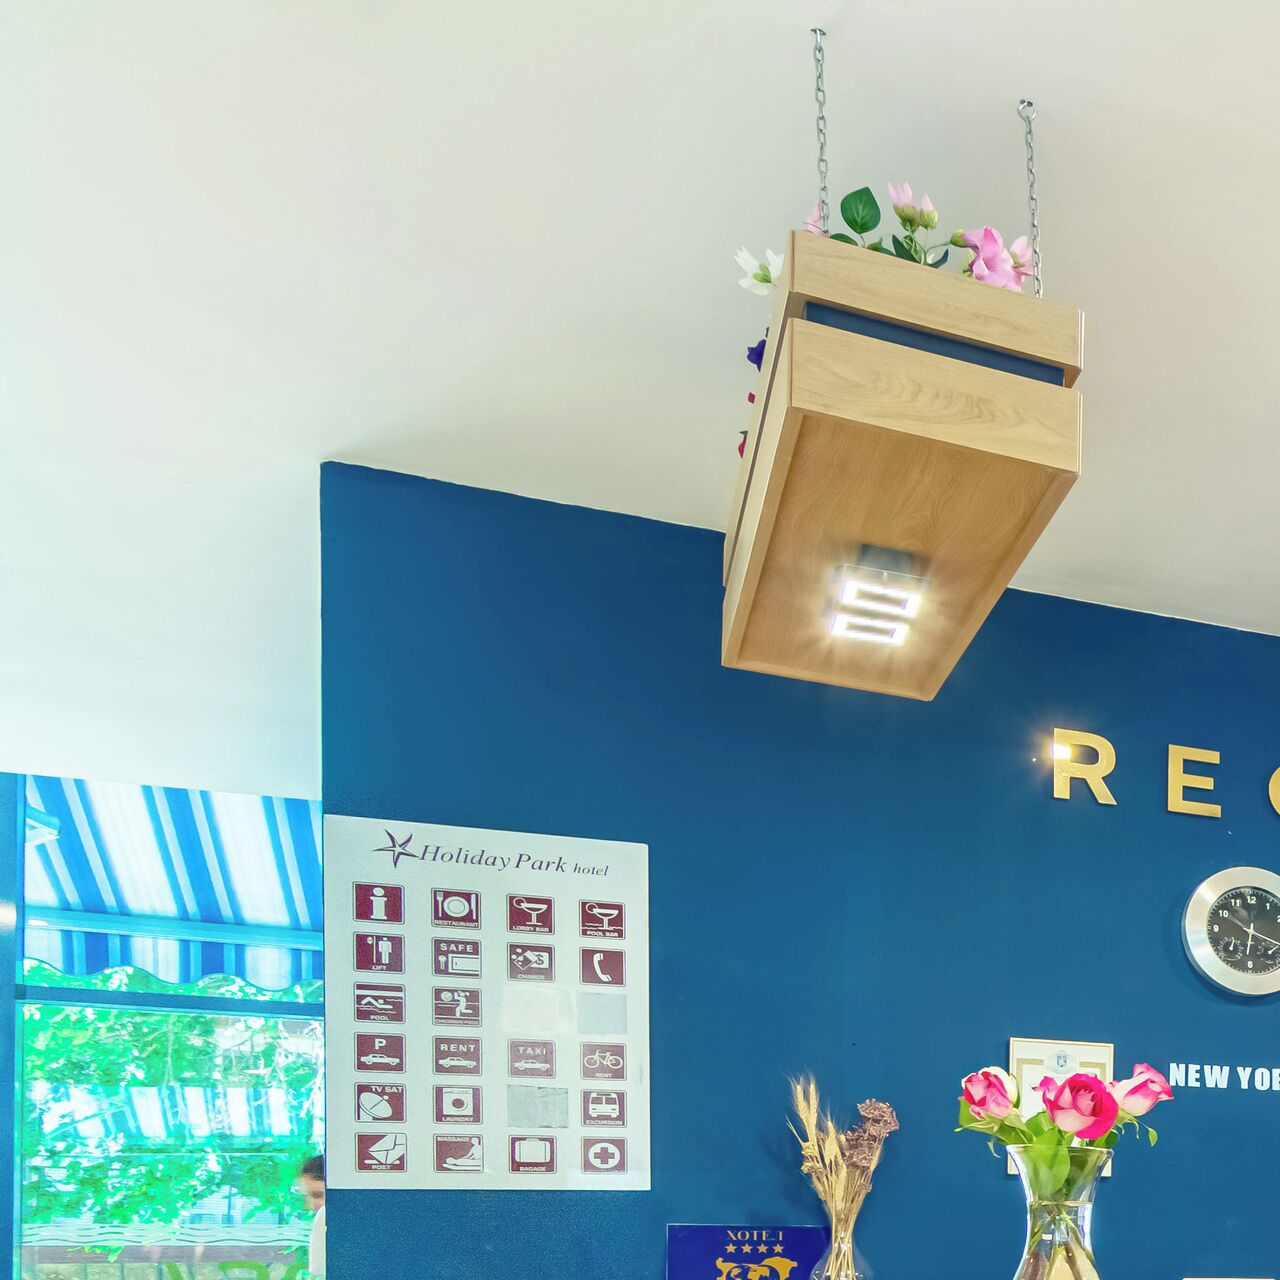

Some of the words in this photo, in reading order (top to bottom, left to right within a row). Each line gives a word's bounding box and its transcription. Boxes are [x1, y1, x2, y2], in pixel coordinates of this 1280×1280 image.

[419, 844, 511, 872] Holiday
[515, 853, 566, 873] Park
[573, 862, 609, 876] hotel
[434, 919, 479, 928] RESTAURANT
[440, 943, 473, 953] SAFE
[374, 1038, 387, 1050] P
[440, 1044, 476, 1052] RENT
[518, 1046, 546, 1055] TAXI
[1169, 1062, 1230, 1089] NEW
[370, 1085, 383, 1093] TV
[727, 1230, 783, 1241] ХОТЕЛ
